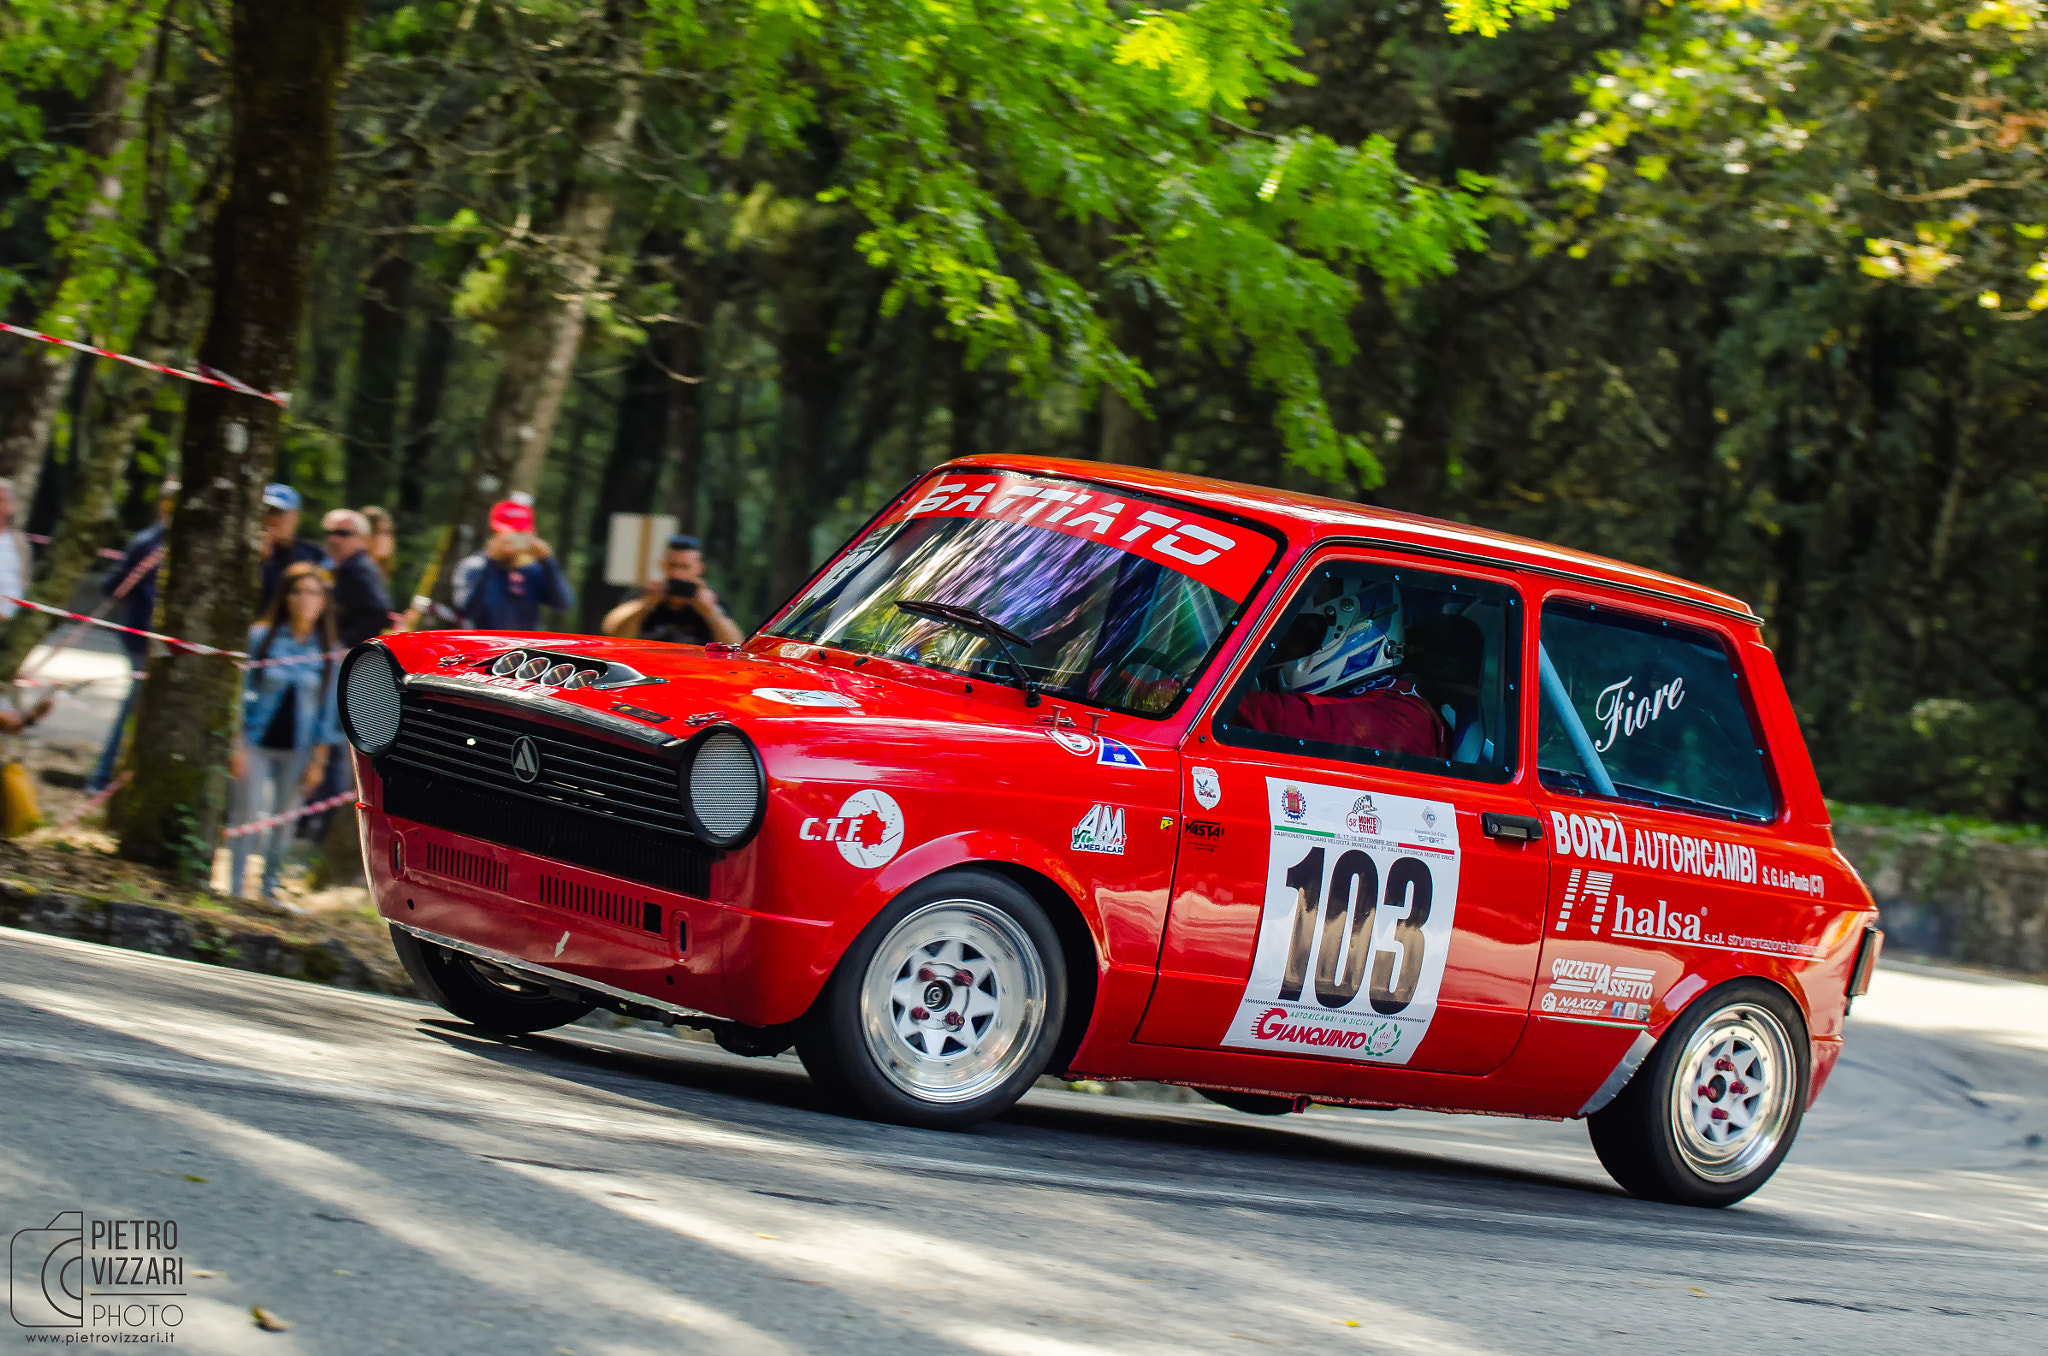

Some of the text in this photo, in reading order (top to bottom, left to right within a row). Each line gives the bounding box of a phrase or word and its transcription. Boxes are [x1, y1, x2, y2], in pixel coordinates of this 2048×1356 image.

[904, 482, 1236, 566] BATTIATO
[1595, 676, 1685, 752] Fiore
[799, 817, 864, 841] C.T.F.
[1273, 830, 1305, 840] CAMPIONATO
[1305, 834, 1326, 843] ITALIANO
[1550, 811, 1628, 864] BORZÌ
[1633, 828, 1757, 885] AUTORICAMBI
[1278, 847, 1433, 1015] 103
[1703, 932, 1726, 945] s.r.l.
[1558, 996, 1607, 1011] NAXOS
[1289, 1011, 1336, 1022] AUTORICAMBI
[1349, 1018, 1374, 1026] SICILIA
